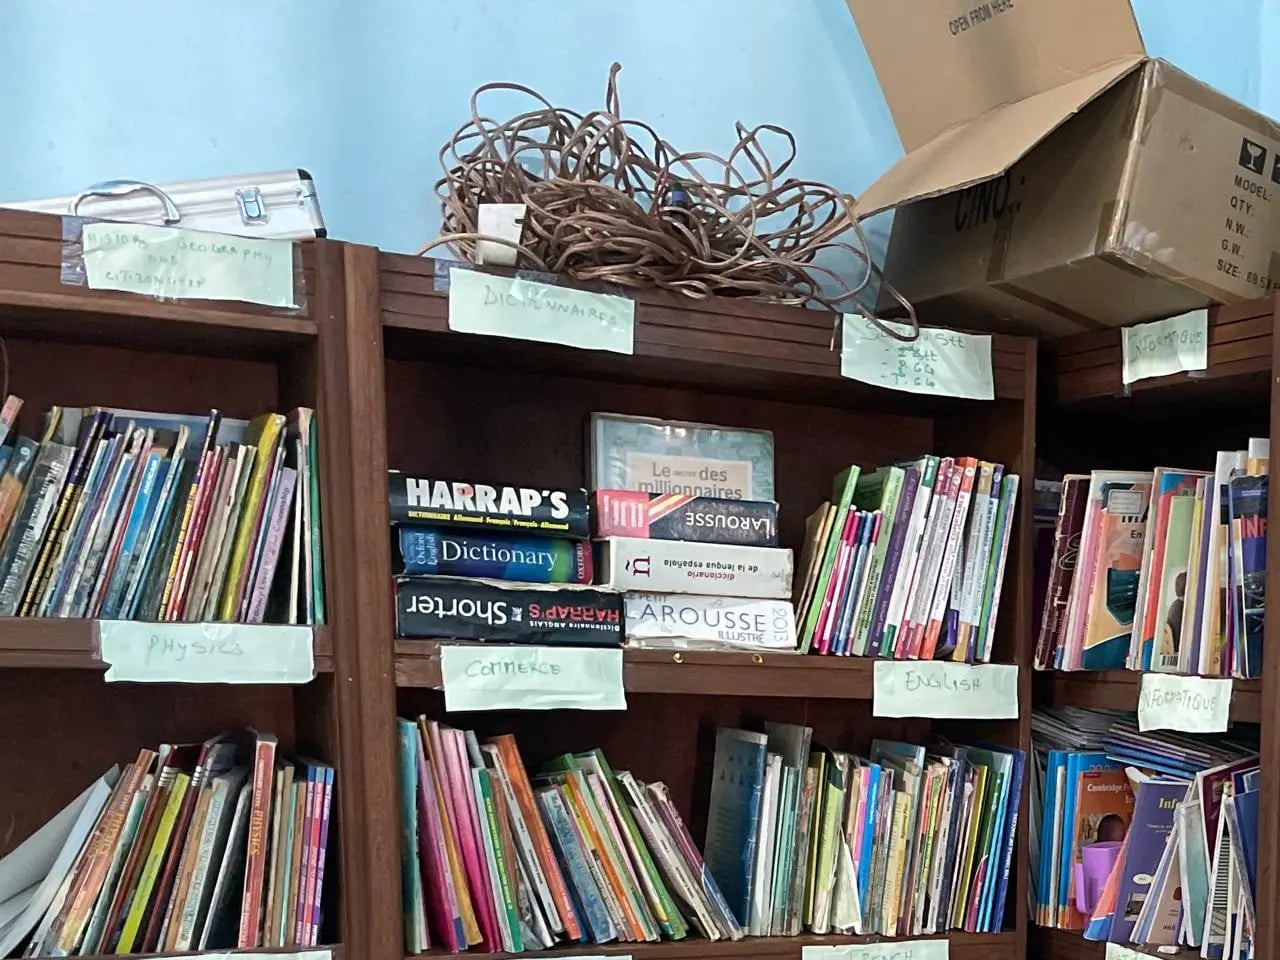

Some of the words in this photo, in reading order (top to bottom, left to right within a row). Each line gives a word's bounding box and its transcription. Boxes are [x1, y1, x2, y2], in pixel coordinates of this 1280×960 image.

[948, 19, 970, 37] OPEN
[970, 9, 992, 29] FROM
[1234, 175, 1272, 202] MODEL:
[652, 462, 672, 478] Le
[699, 467, 728, 482] des
[405, 478, 569, 520] HARRAP'S
[637, 479, 743, 500] millionnaires
[685, 512, 771, 540] LAROUSSE
[441, 539, 559, 571] Dictionary
[577, 543, 586, 579] OXFORD
[663, 559, 703, 570] española
[703, 561, 736, 572] lengua
[687, 570, 736, 581] diccionario
[747, 564, 759, 573] de
[406, 595, 508, 626] Shorter
[529, 603, 620, 621] HARRAP'S
[625, 602, 766, 634] LAROUSSE
[529, 619, 570, 630] ANGLAIS
[772, 607, 788, 642] 2013
[146, 634, 244, 668] PHYSICS
[464, 659, 561, 678] COMMERCE
[904, 671, 982, 692] ENGLISH
[1087, 783, 1122, 794] Cambridge
[249, 809, 263, 854] PHYSICS
